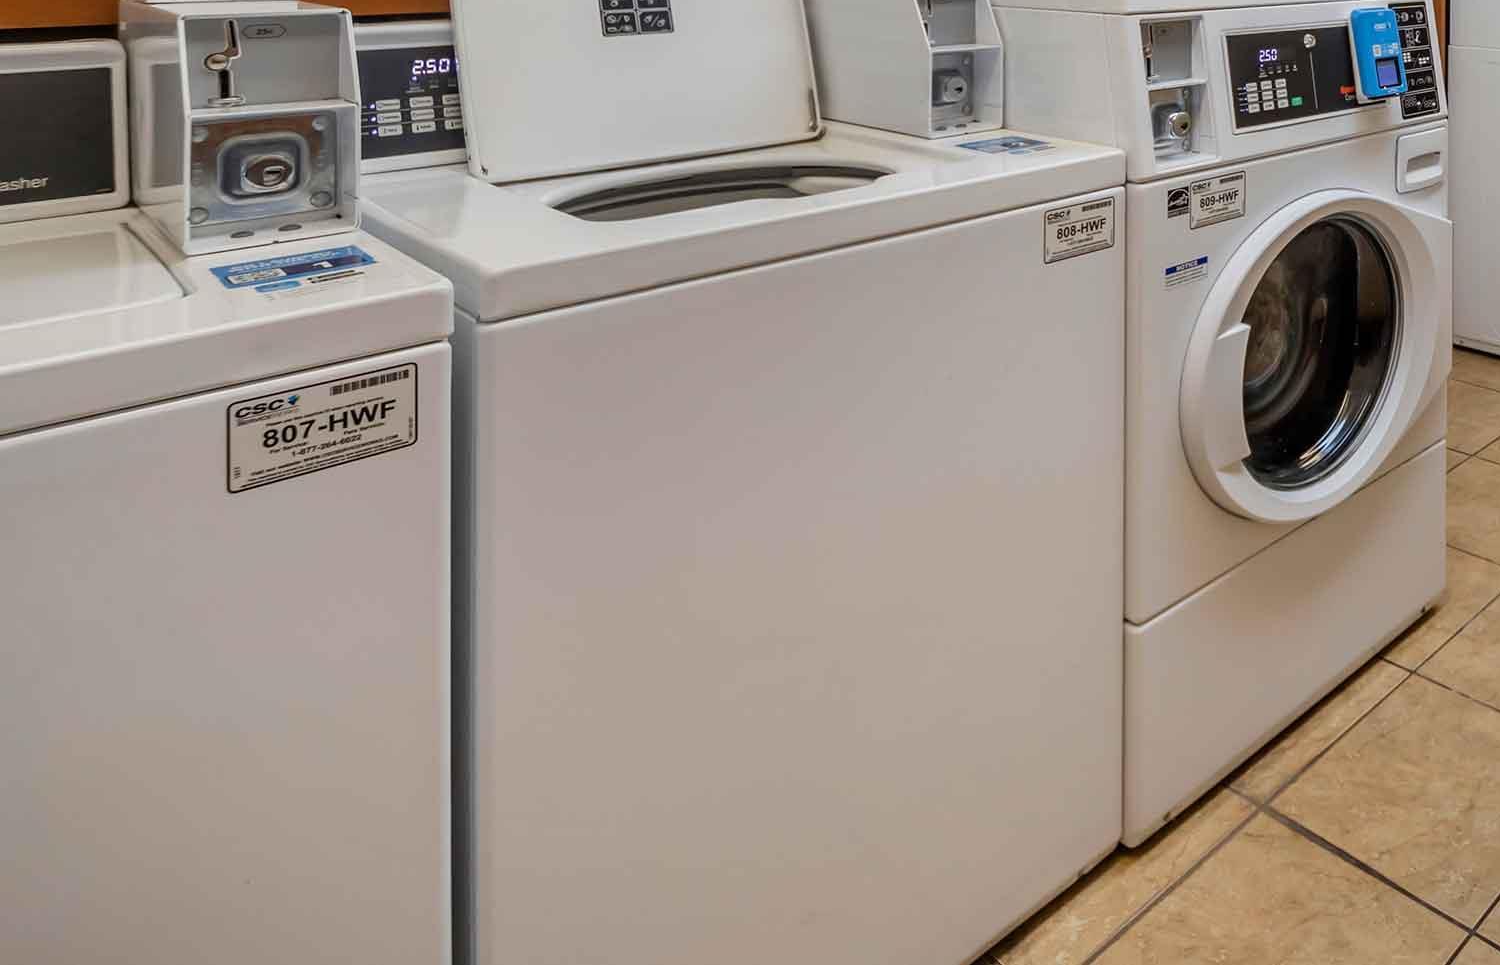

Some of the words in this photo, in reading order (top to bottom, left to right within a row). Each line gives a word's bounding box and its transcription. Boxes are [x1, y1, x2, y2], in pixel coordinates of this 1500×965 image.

[412, 57, 451, 75] 2.50
[1200, 189, 1240, 209] 809-HWF
[1056, 217, 1106, 240] 808-HWF
[234, 398, 285, 419] CSC
[262, 398, 397, 449] 807-HWF
